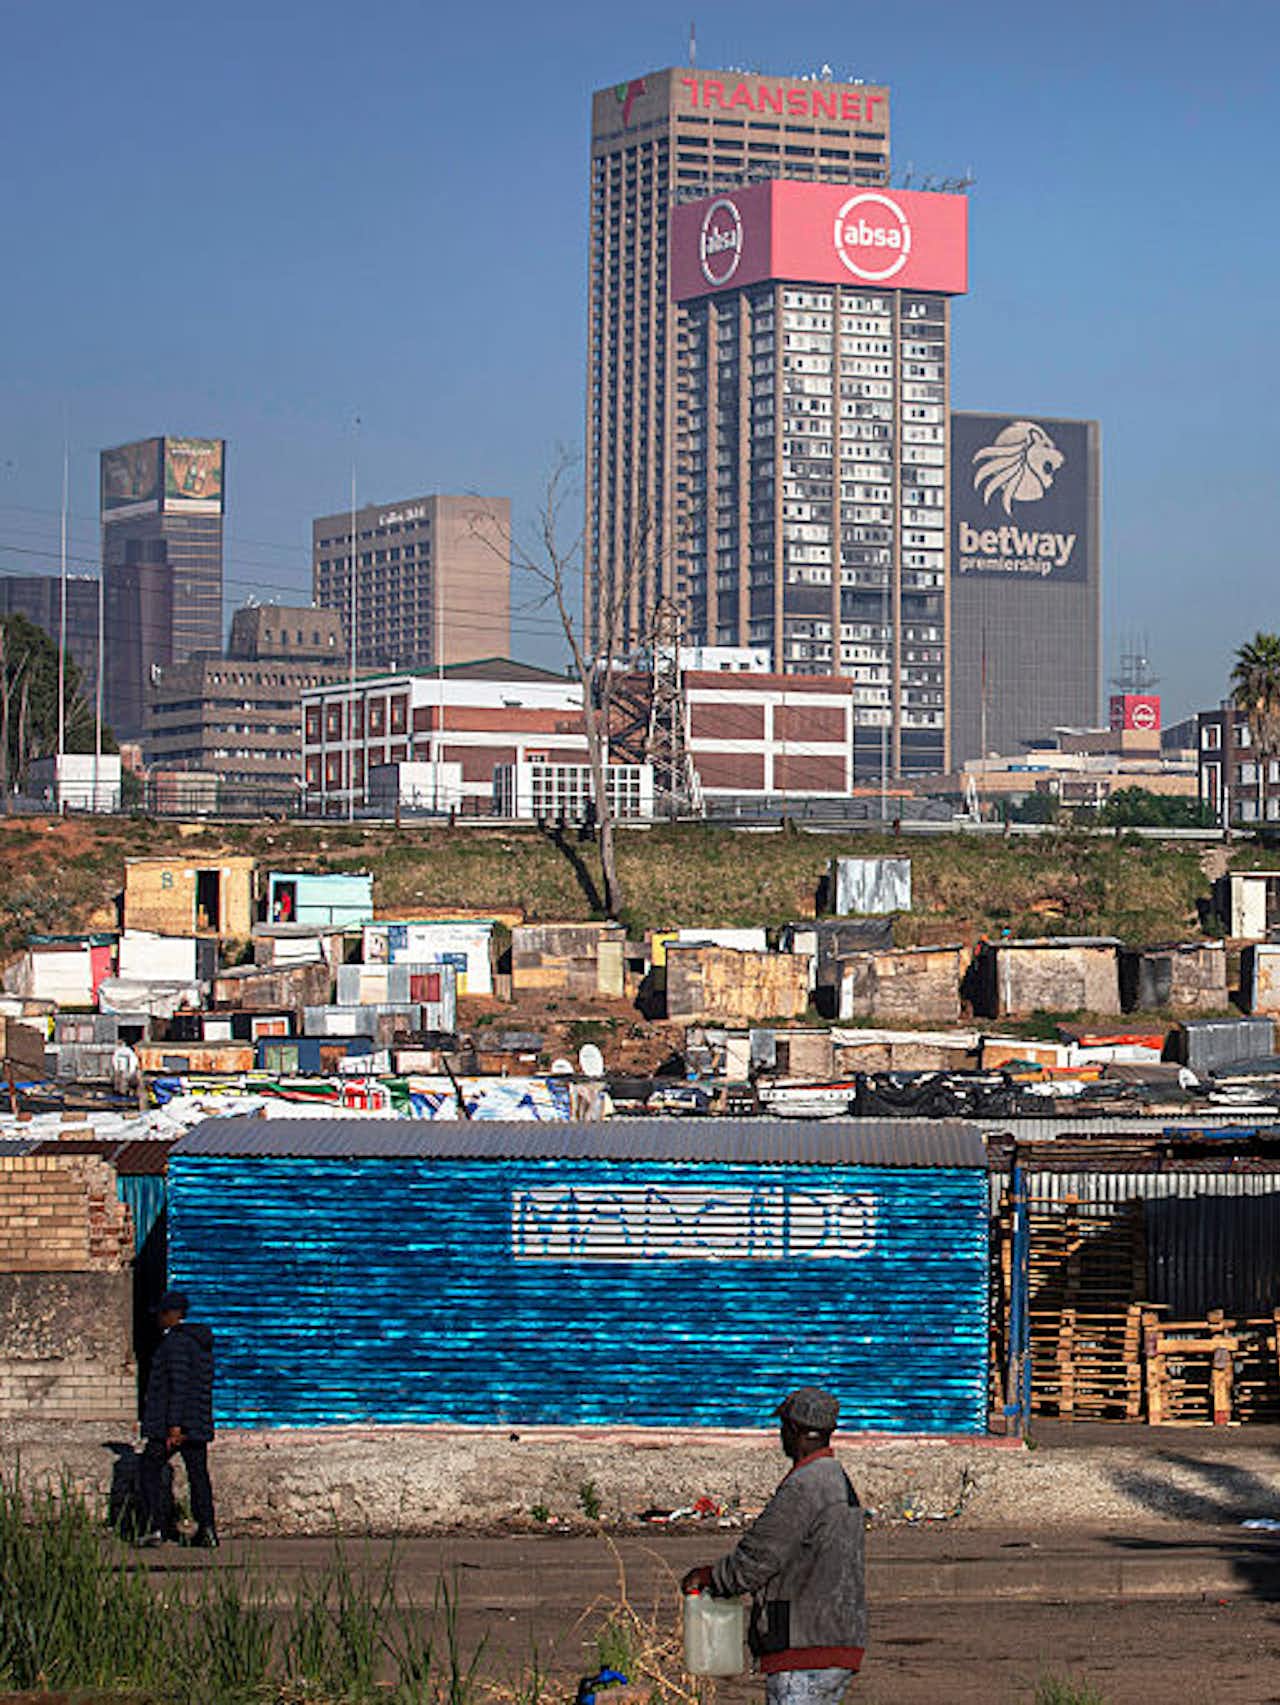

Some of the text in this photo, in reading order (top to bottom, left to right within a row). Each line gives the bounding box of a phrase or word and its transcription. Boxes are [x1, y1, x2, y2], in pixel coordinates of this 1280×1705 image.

[681, 77, 884, 122] TRANSNET
[706, 226, 736, 254] absa
[844, 218, 901, 248] absa
[959, 521, 1076, 566] betway
[959, 557, 1052, 576] premiership
